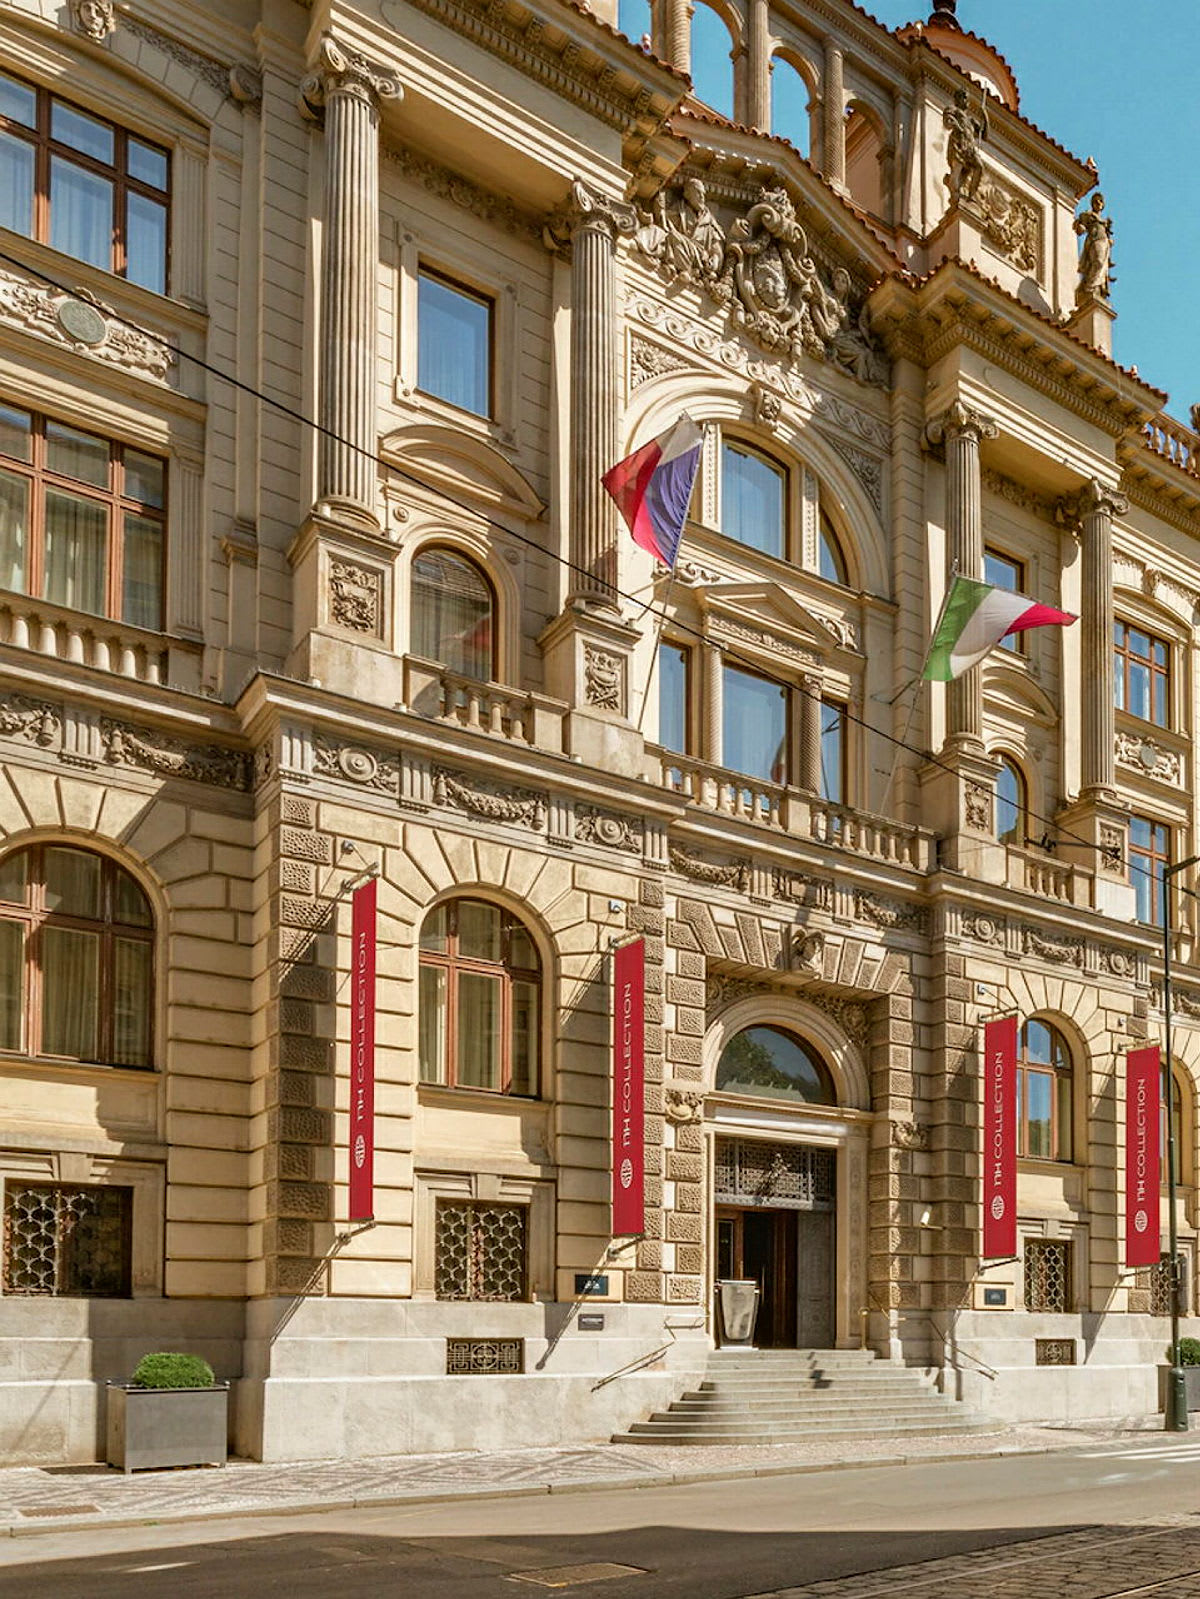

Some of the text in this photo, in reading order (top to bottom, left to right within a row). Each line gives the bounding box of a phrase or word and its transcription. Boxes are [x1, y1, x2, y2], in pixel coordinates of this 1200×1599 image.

[357, 932, 366, 1084] COLLECTION
[623, 983, 632, 1114] COLLECTION
[994, 1051, 1003, 1159] COLLECTION
[1137, 1078, 1146, 1178] COLLECTION
